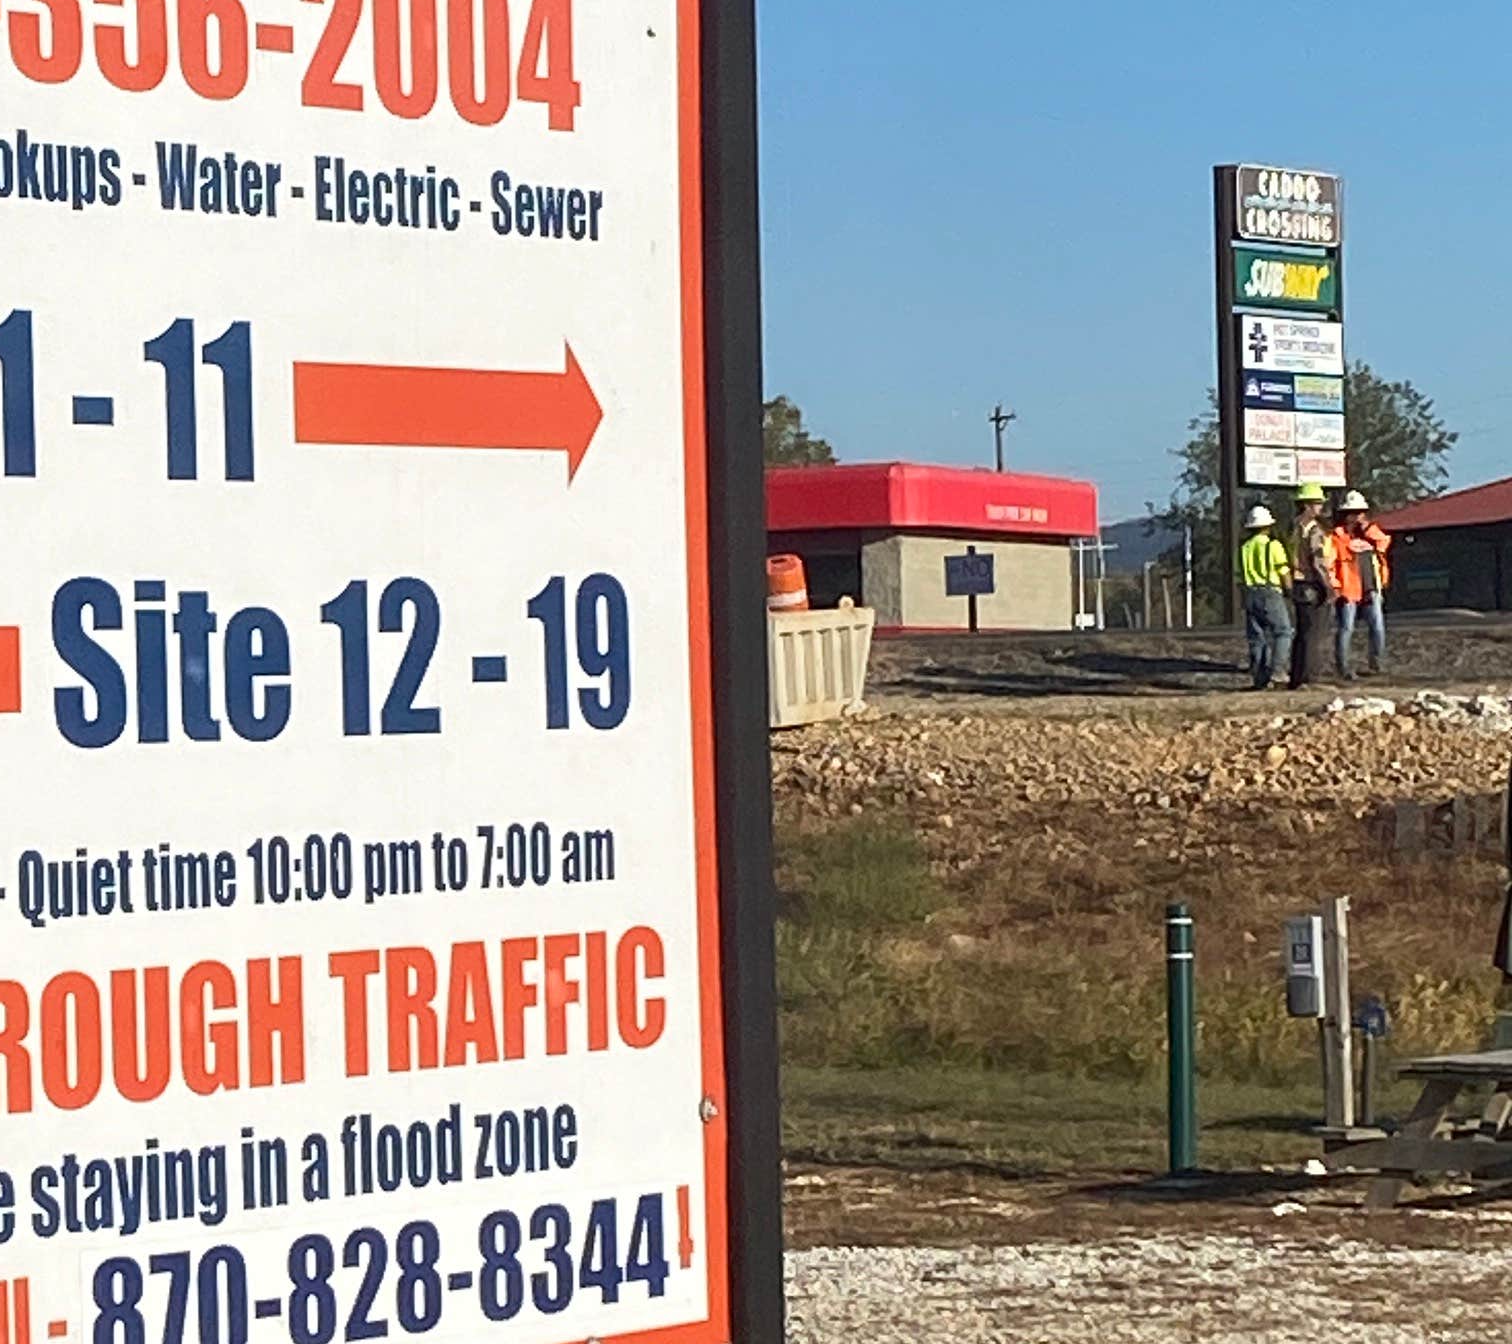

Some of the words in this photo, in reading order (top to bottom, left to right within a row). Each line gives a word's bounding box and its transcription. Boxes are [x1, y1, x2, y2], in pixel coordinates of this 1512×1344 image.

[156, 142, 280, 217] Water
[315, 156, 459, 231] Electric
[491, 171, 602, 241] Sewer
[1246, 208, 1333, 241] CROSSING
[1258, 170, 1322, 201] CADDO
[1244, 258, 1330, 301] SUBWAY
[144, 318, 254, 481] 11
[52, 577, 291, 748] Site
[321, 577, 441, 736] 12
[528, 573, 630, 729] 19
[19, 851, 133, 927] Quiet
[143, 849, 236, 911] time
[247, 833, 352, 904] 10:00
[365, 841, 422, 903] pm
[432, 833, 467, 891] to
[478, 822, 550, 888] 7:00
[562, 830, 614, 883] am
[329, 926, 665, 1077] TRAFFIC
[31, 1139, 227, 1237] staying
[242, 1127, 287, 1209] in
[302, 1134, 329, 1202] a
[341, 1104, 462, 1196] flood
[475, 1104, 577, 1179] zone
